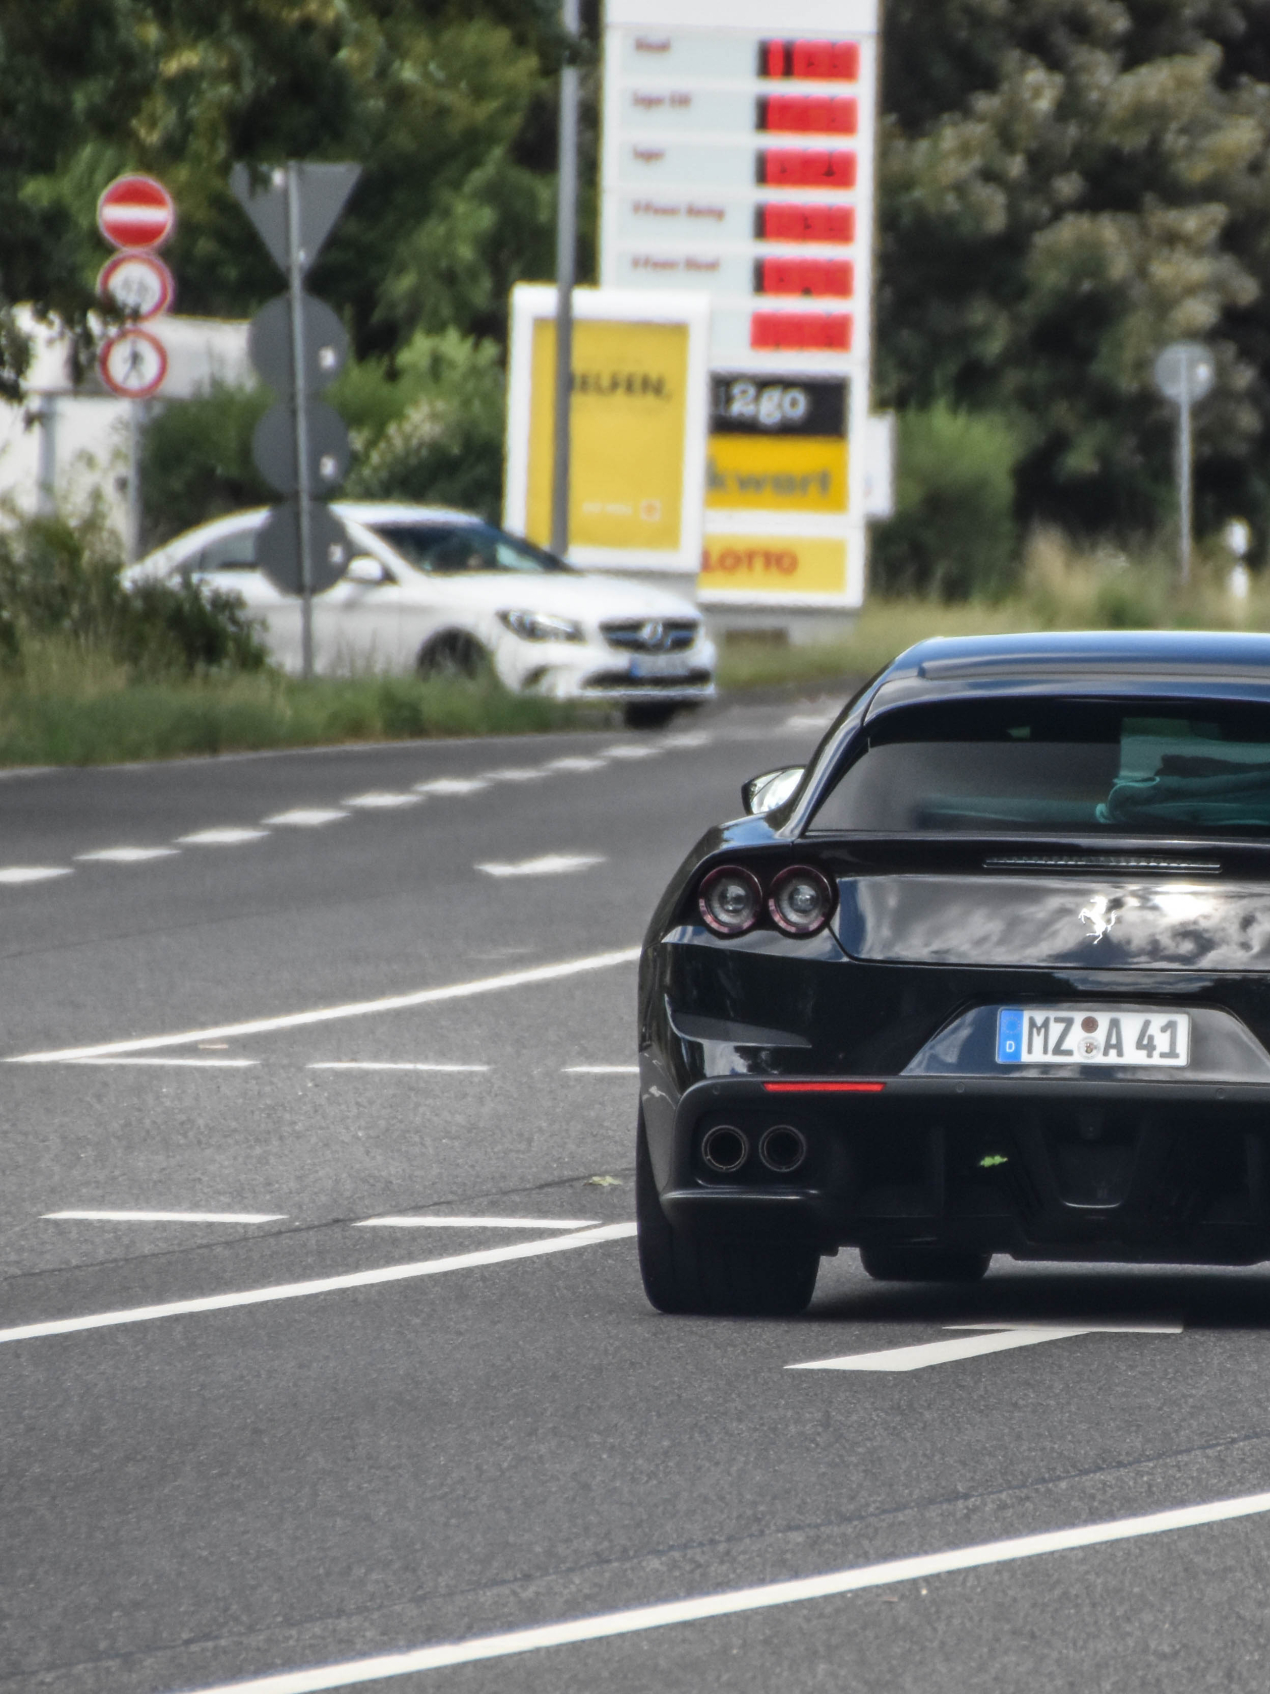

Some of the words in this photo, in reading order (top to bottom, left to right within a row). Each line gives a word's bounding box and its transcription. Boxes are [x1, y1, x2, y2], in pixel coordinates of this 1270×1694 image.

[701, 547, 799, 576] LOTTO
[1005, 1040, 1015, 1053] D
[1027, 1016, 1075, 1056] MZ
[1102, 1017, 1124, 1057] A
[1135, 1019, 1180, 1059] 41
